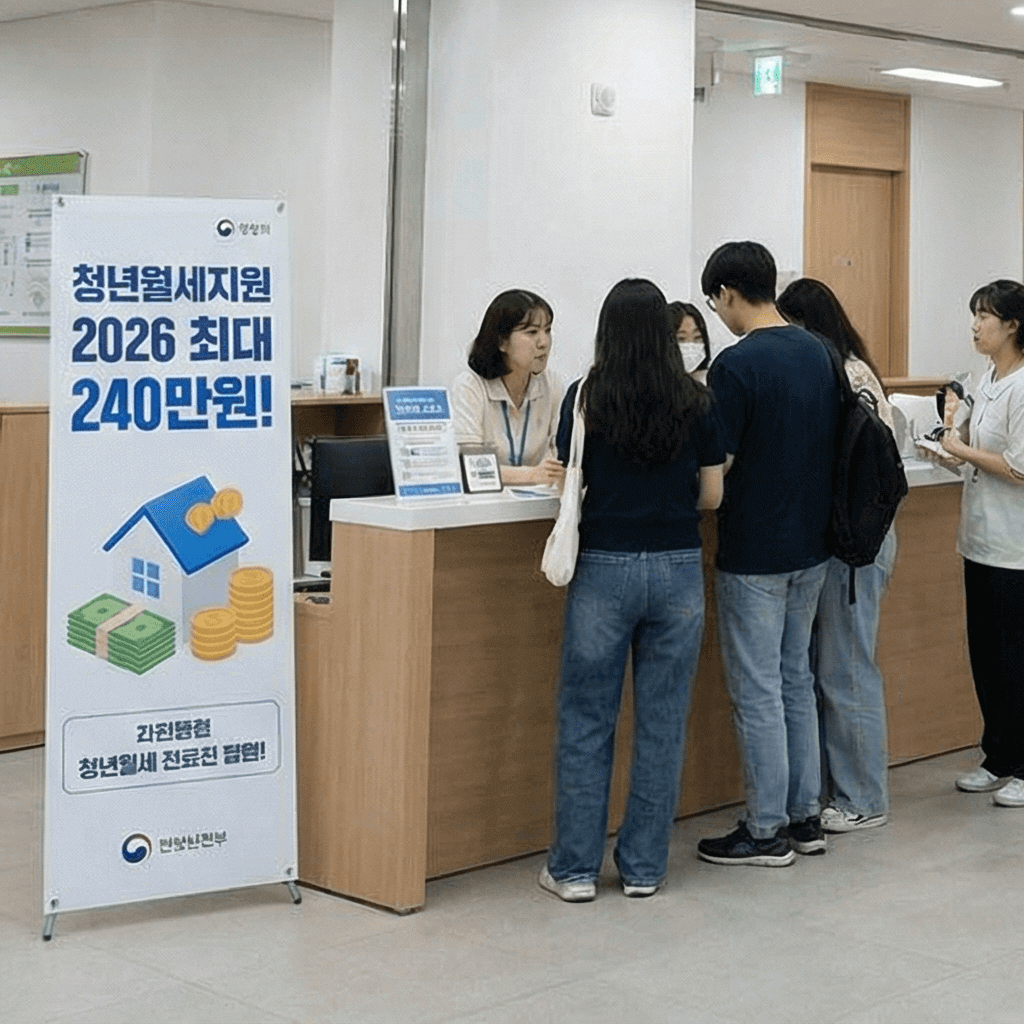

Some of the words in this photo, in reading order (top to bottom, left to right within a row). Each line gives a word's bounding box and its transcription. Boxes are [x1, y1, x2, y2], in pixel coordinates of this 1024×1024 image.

[72, 264, 272, 304] 청년월세지원
[71, 316, 176, 363] 2026
[189, 315, 273, 363] 최대
[70, 375, 273, 433] 240만원!
